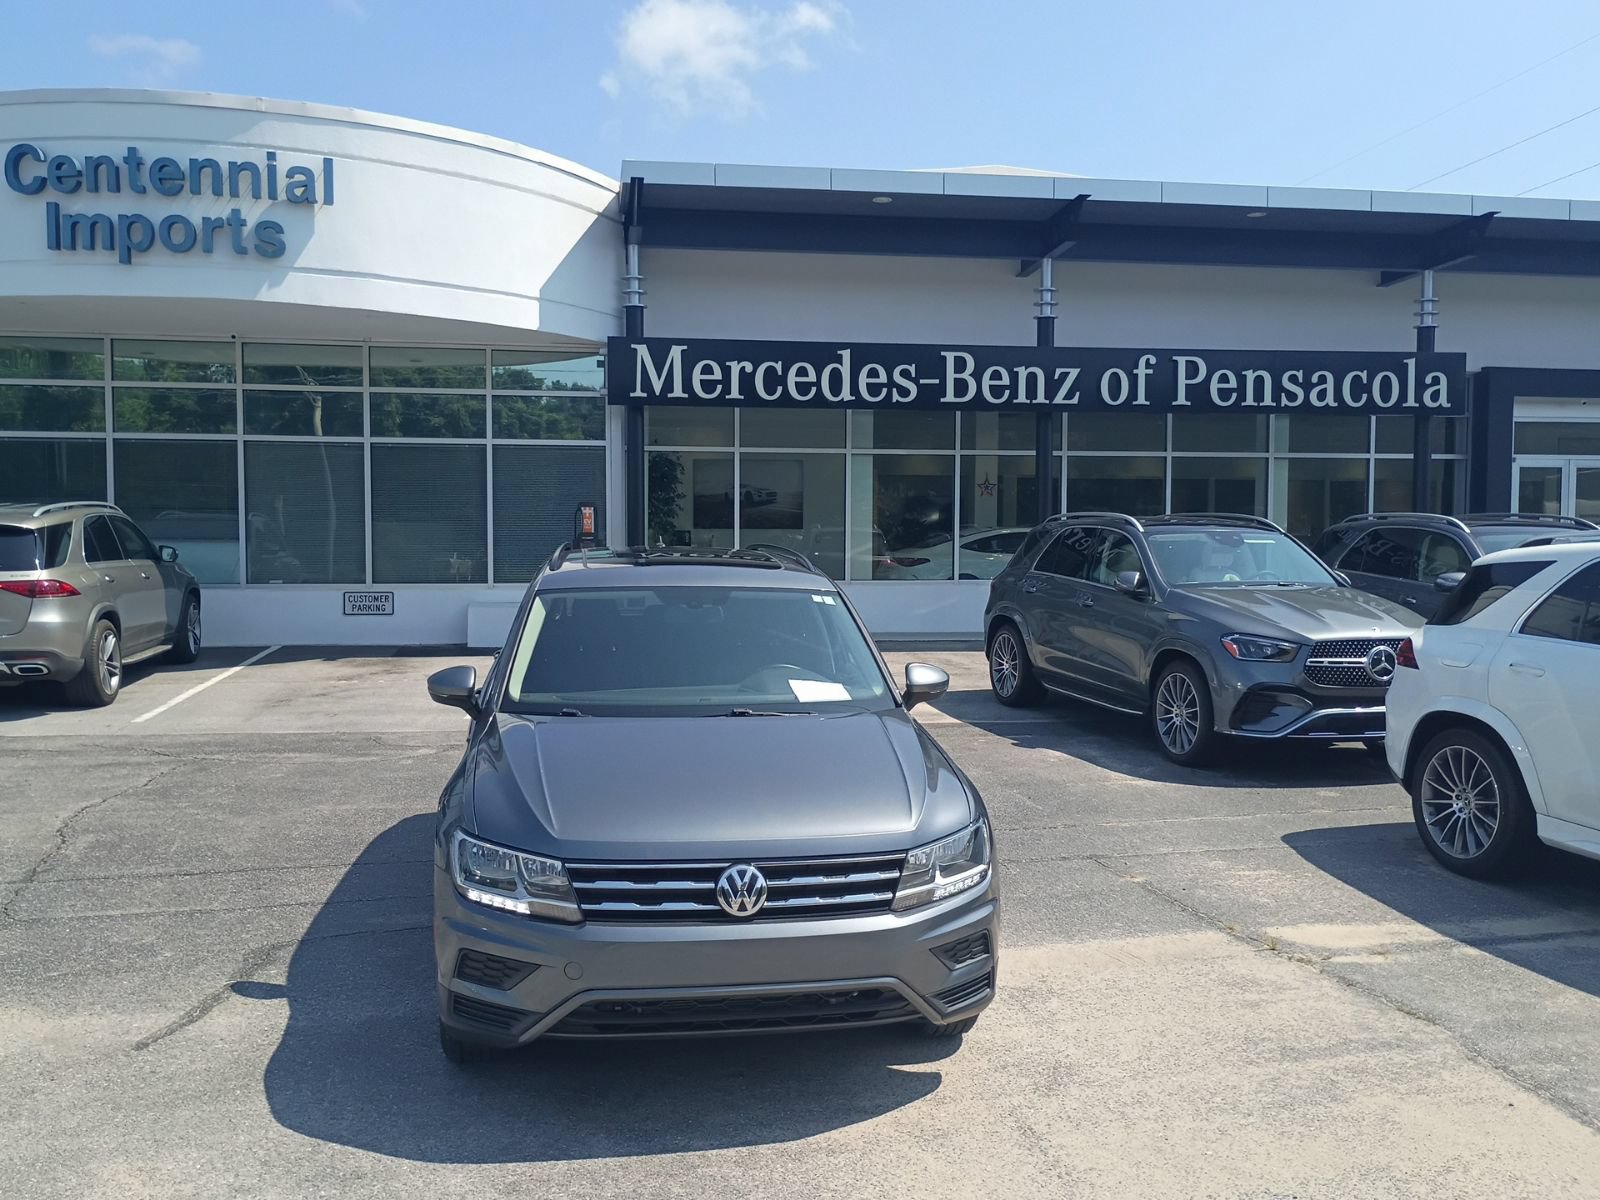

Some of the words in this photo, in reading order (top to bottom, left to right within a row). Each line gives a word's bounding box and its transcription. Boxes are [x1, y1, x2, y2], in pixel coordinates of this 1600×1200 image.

[4, 143, 334, 206] Centennial
[46, 202, 286, 264] Imports
[629, 343, 1081, 405] Mercedes-Benz
[1100, 354, 1157, 406] of
[1171, 355, 1451, 408] Pensacola
[348, 594, 390, 603] CUSTOMER
[351, 604, 386, 612] PARKING
